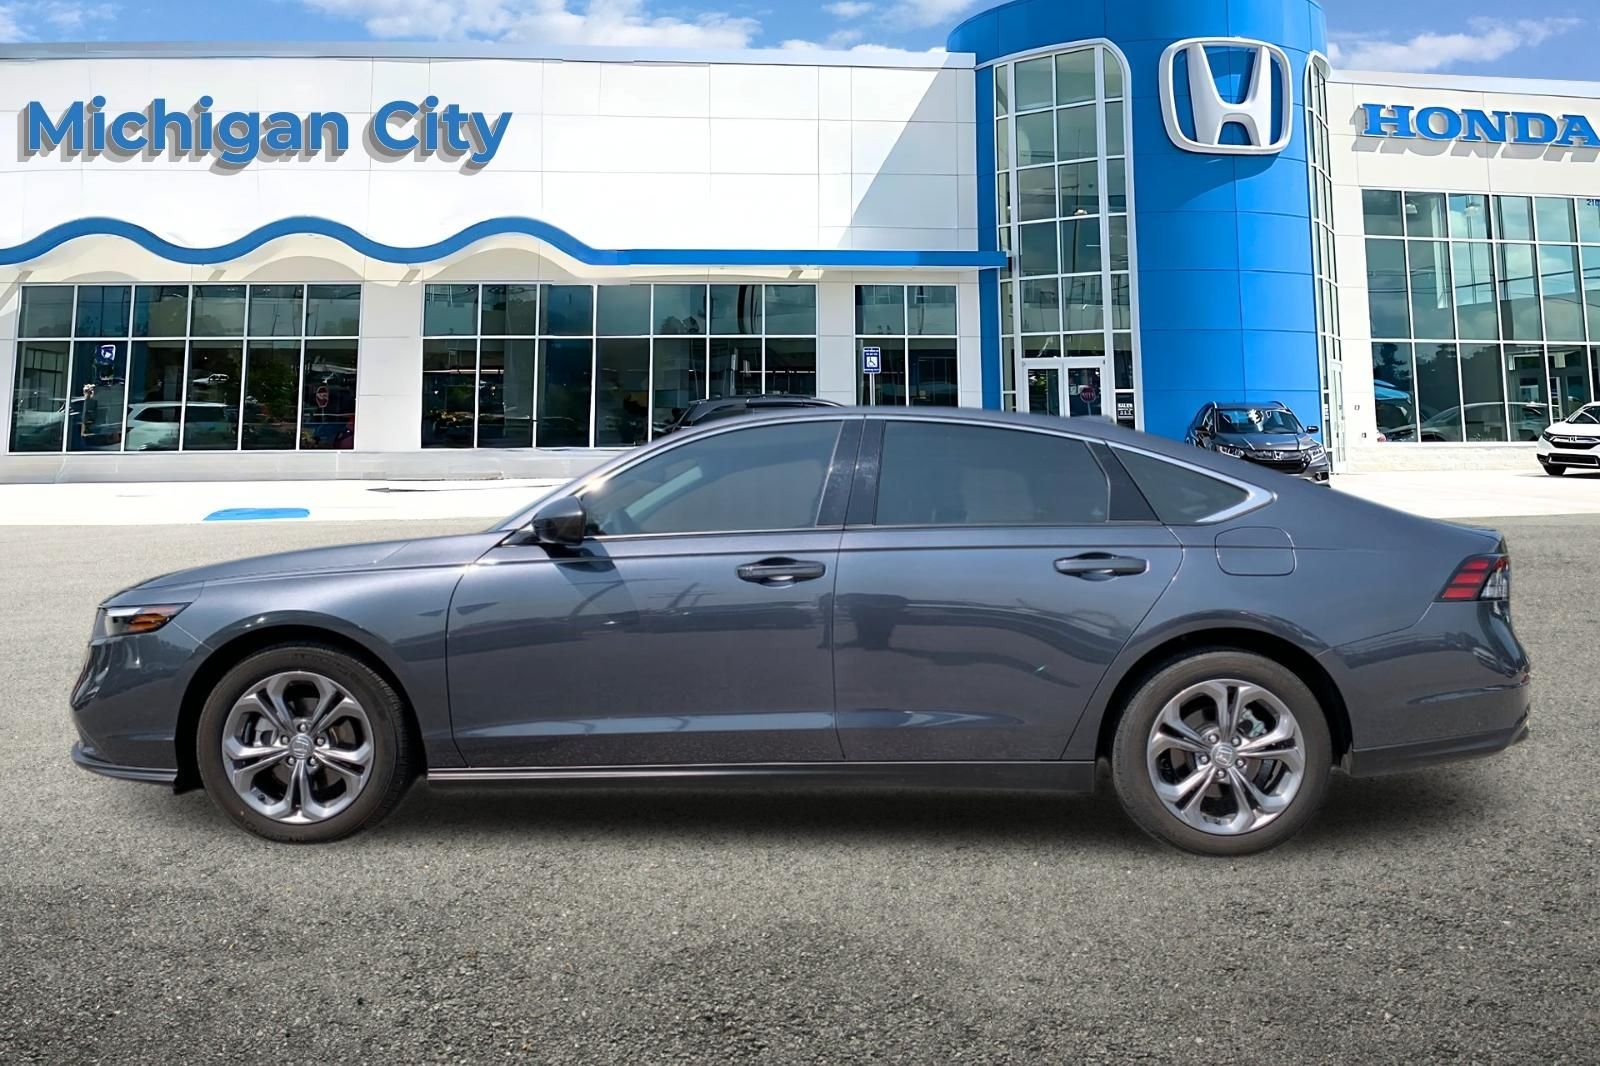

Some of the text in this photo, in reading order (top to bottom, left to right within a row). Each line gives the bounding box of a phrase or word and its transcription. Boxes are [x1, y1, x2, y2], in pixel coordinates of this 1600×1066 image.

[27, 96, 513, 164] Michigan City
[1361, 103, 1600, 148] HONDA
